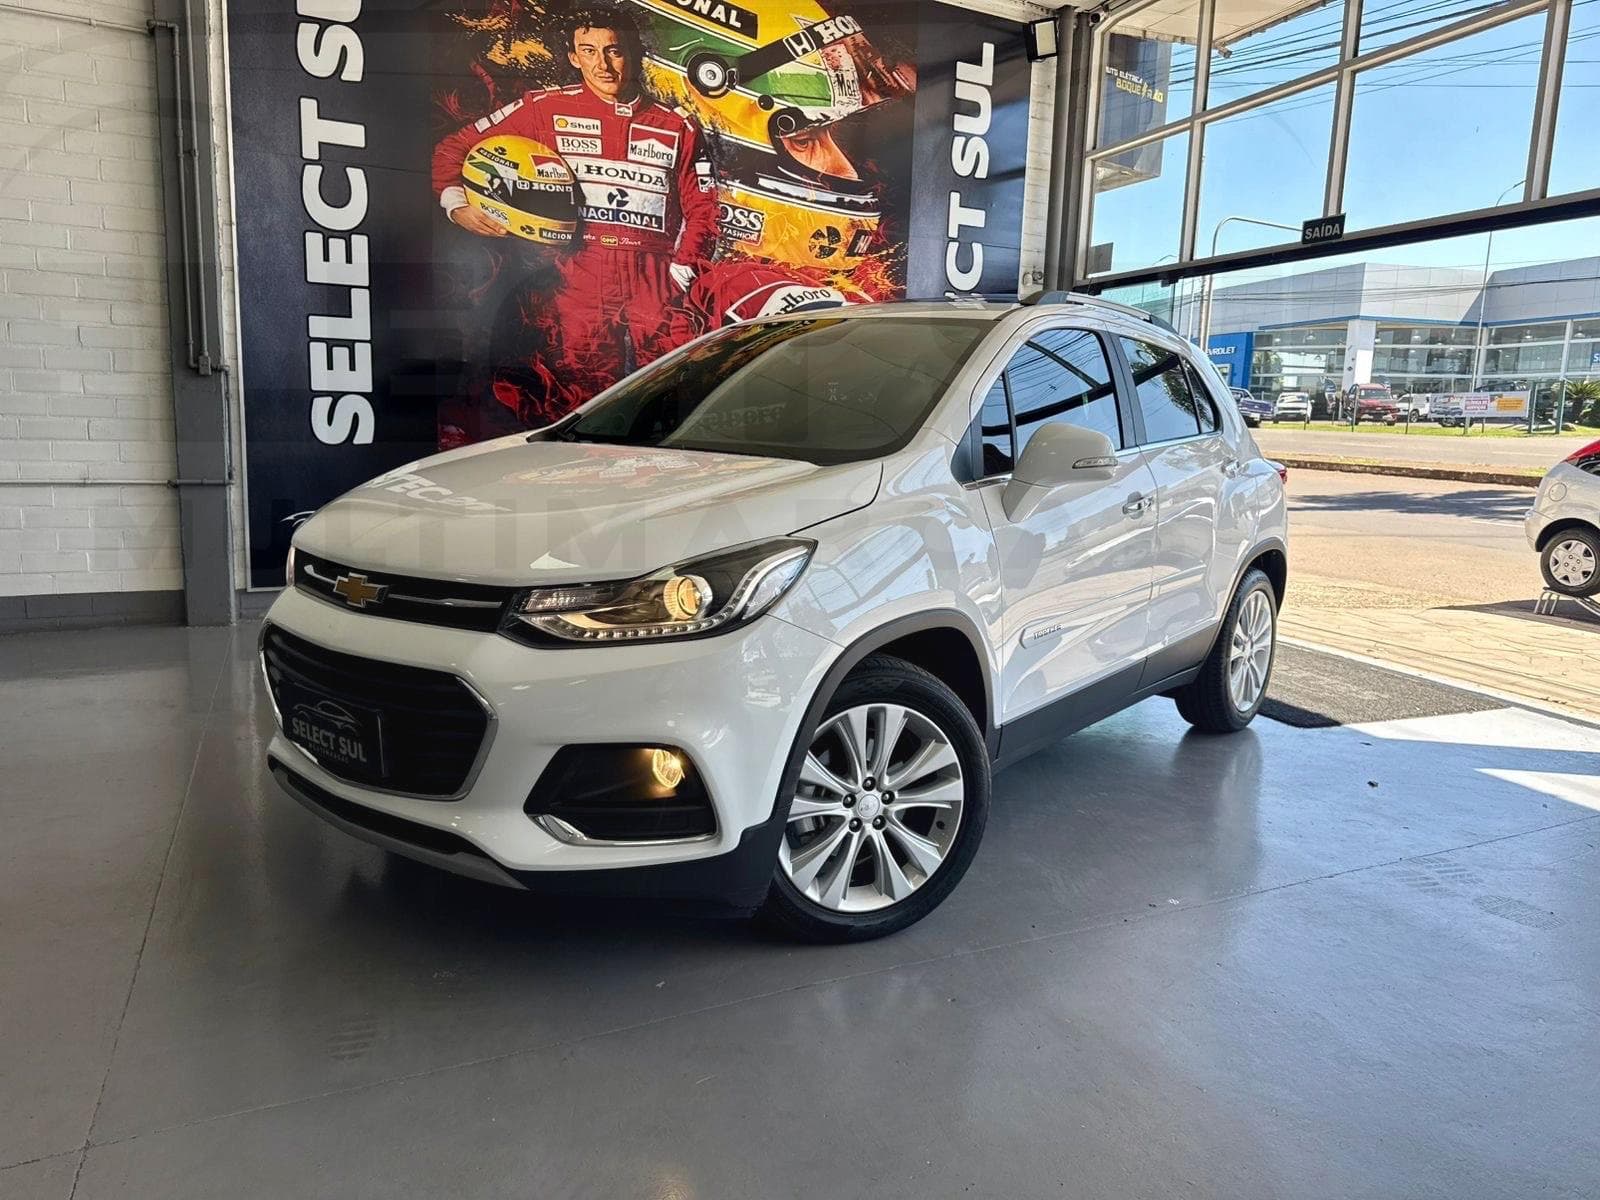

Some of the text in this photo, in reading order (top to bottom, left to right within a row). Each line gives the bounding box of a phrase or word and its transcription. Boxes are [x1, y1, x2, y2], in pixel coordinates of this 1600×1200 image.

[570, 122, 599, 131] Shell
[561, 138, 598, 150] BOSS
[630, 143, 673, 162] Marlboro
[479, 149, 515, 170] NACIONAL
[584, 164, 667, 188] HONDA
[944, 42, 995, 299] CT SUL
[296, 0, 375, 445] SELECT S
[1304, 222, 1341, 241] SAÍDA
[292, 717, 367, 763] SELECT SUL
